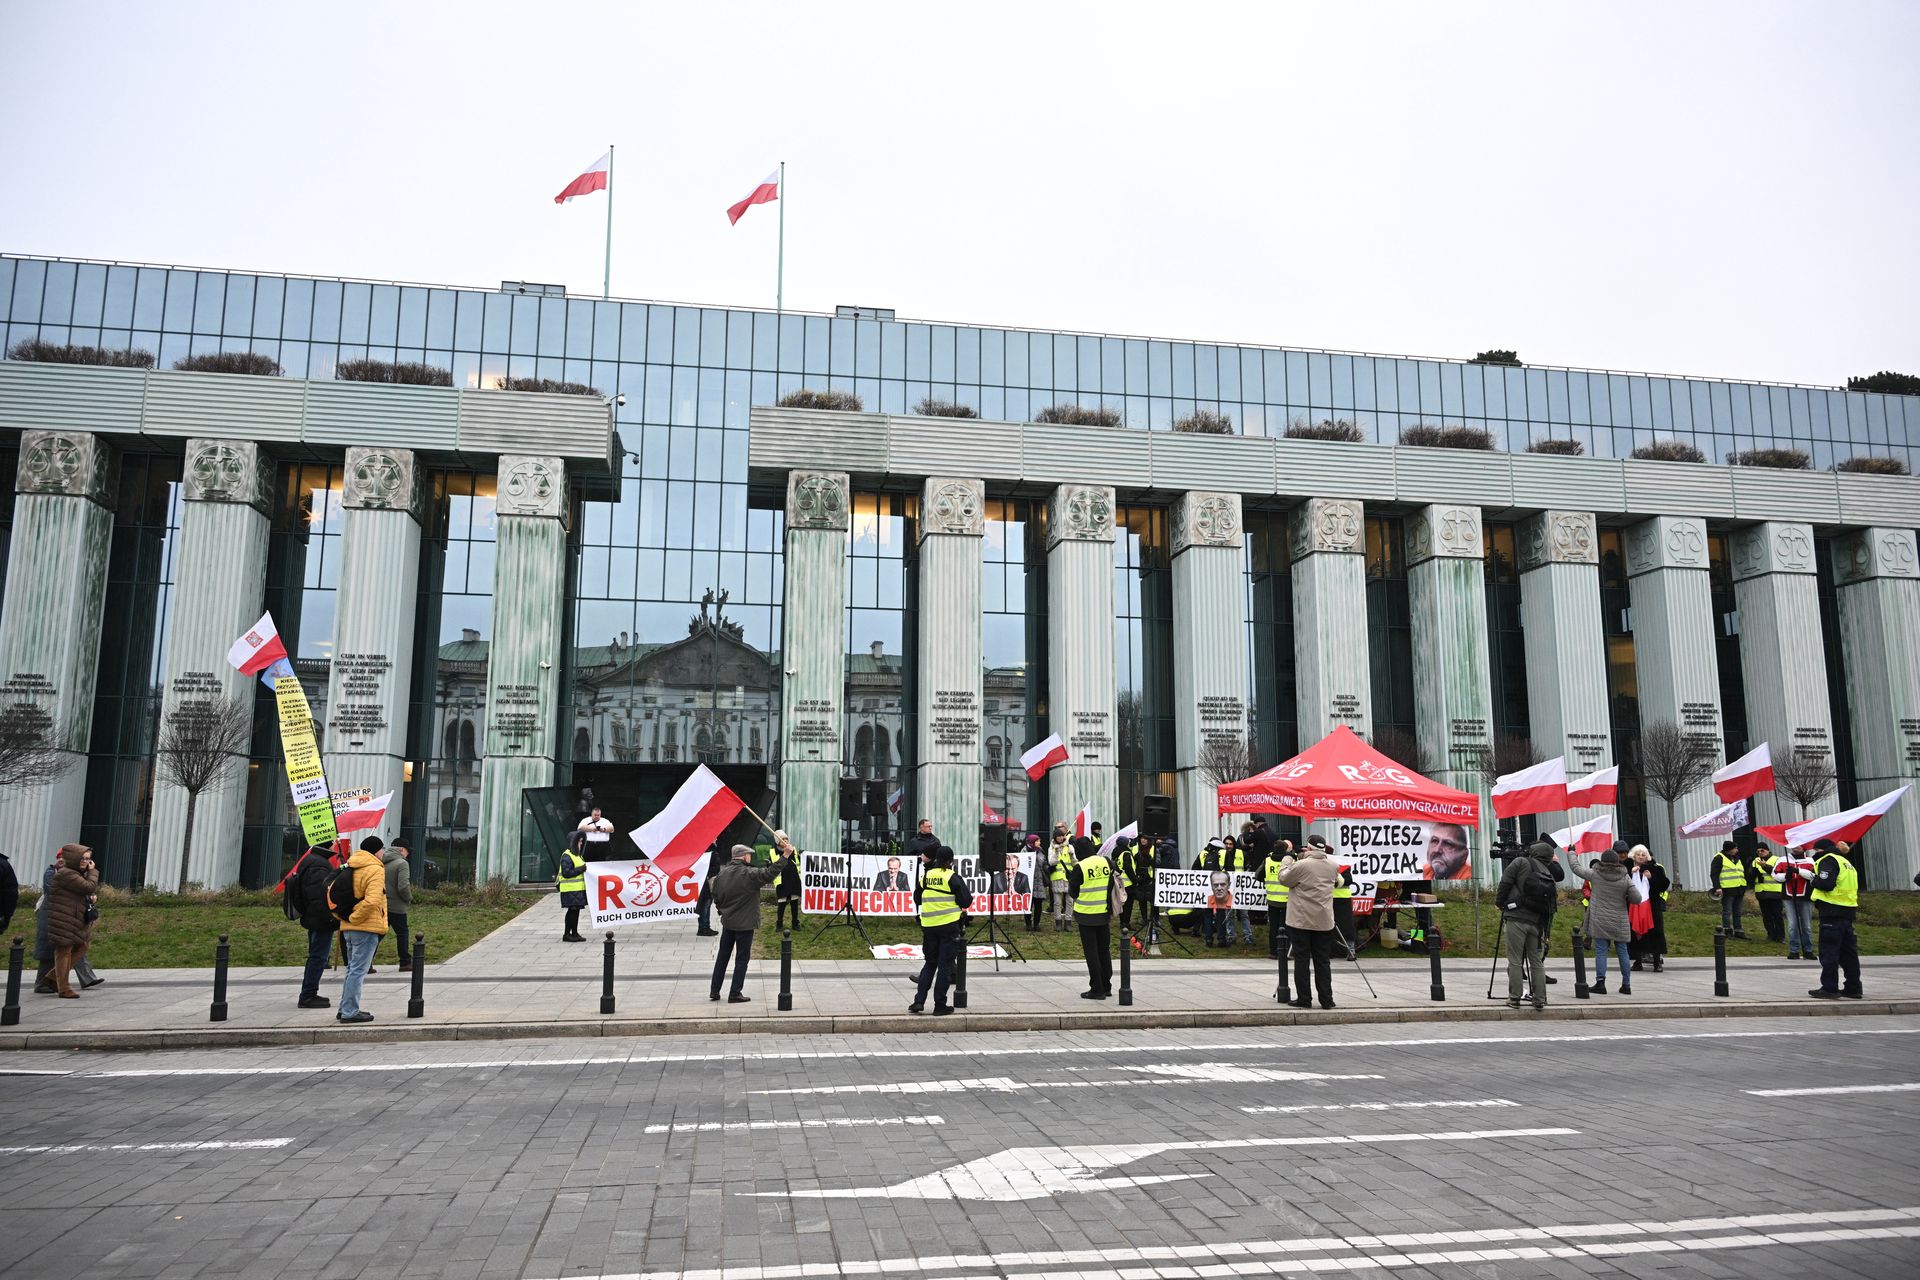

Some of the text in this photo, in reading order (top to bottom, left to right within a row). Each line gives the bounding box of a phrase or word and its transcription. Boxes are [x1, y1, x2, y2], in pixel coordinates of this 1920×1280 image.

[296, 780, 320, 788] DELEGA
[296, 785, 322, 795] LIZACJA
[362, 788, 372, 796] RP
[1342, 798, 1474, 816] RUCHOBRONYGRANIC.PL
[316, 834, 332, 842] KURS
[1340, 824, 1422, 852] BĘDZIESZ
[806, 855, 844, 874] MAM
[1344, 852, 1423, 874] IEDZIAŁ
[1159, 872, 1208, 888] BĘDZIESZ
[804, 889, 913, 912] NIEMIECKIE
[1159, 890, 1207, 904] SIEDZIAŁ
[597, 913, 622, 923] RUCH
[625, 909, 664, 919] OBRONY
